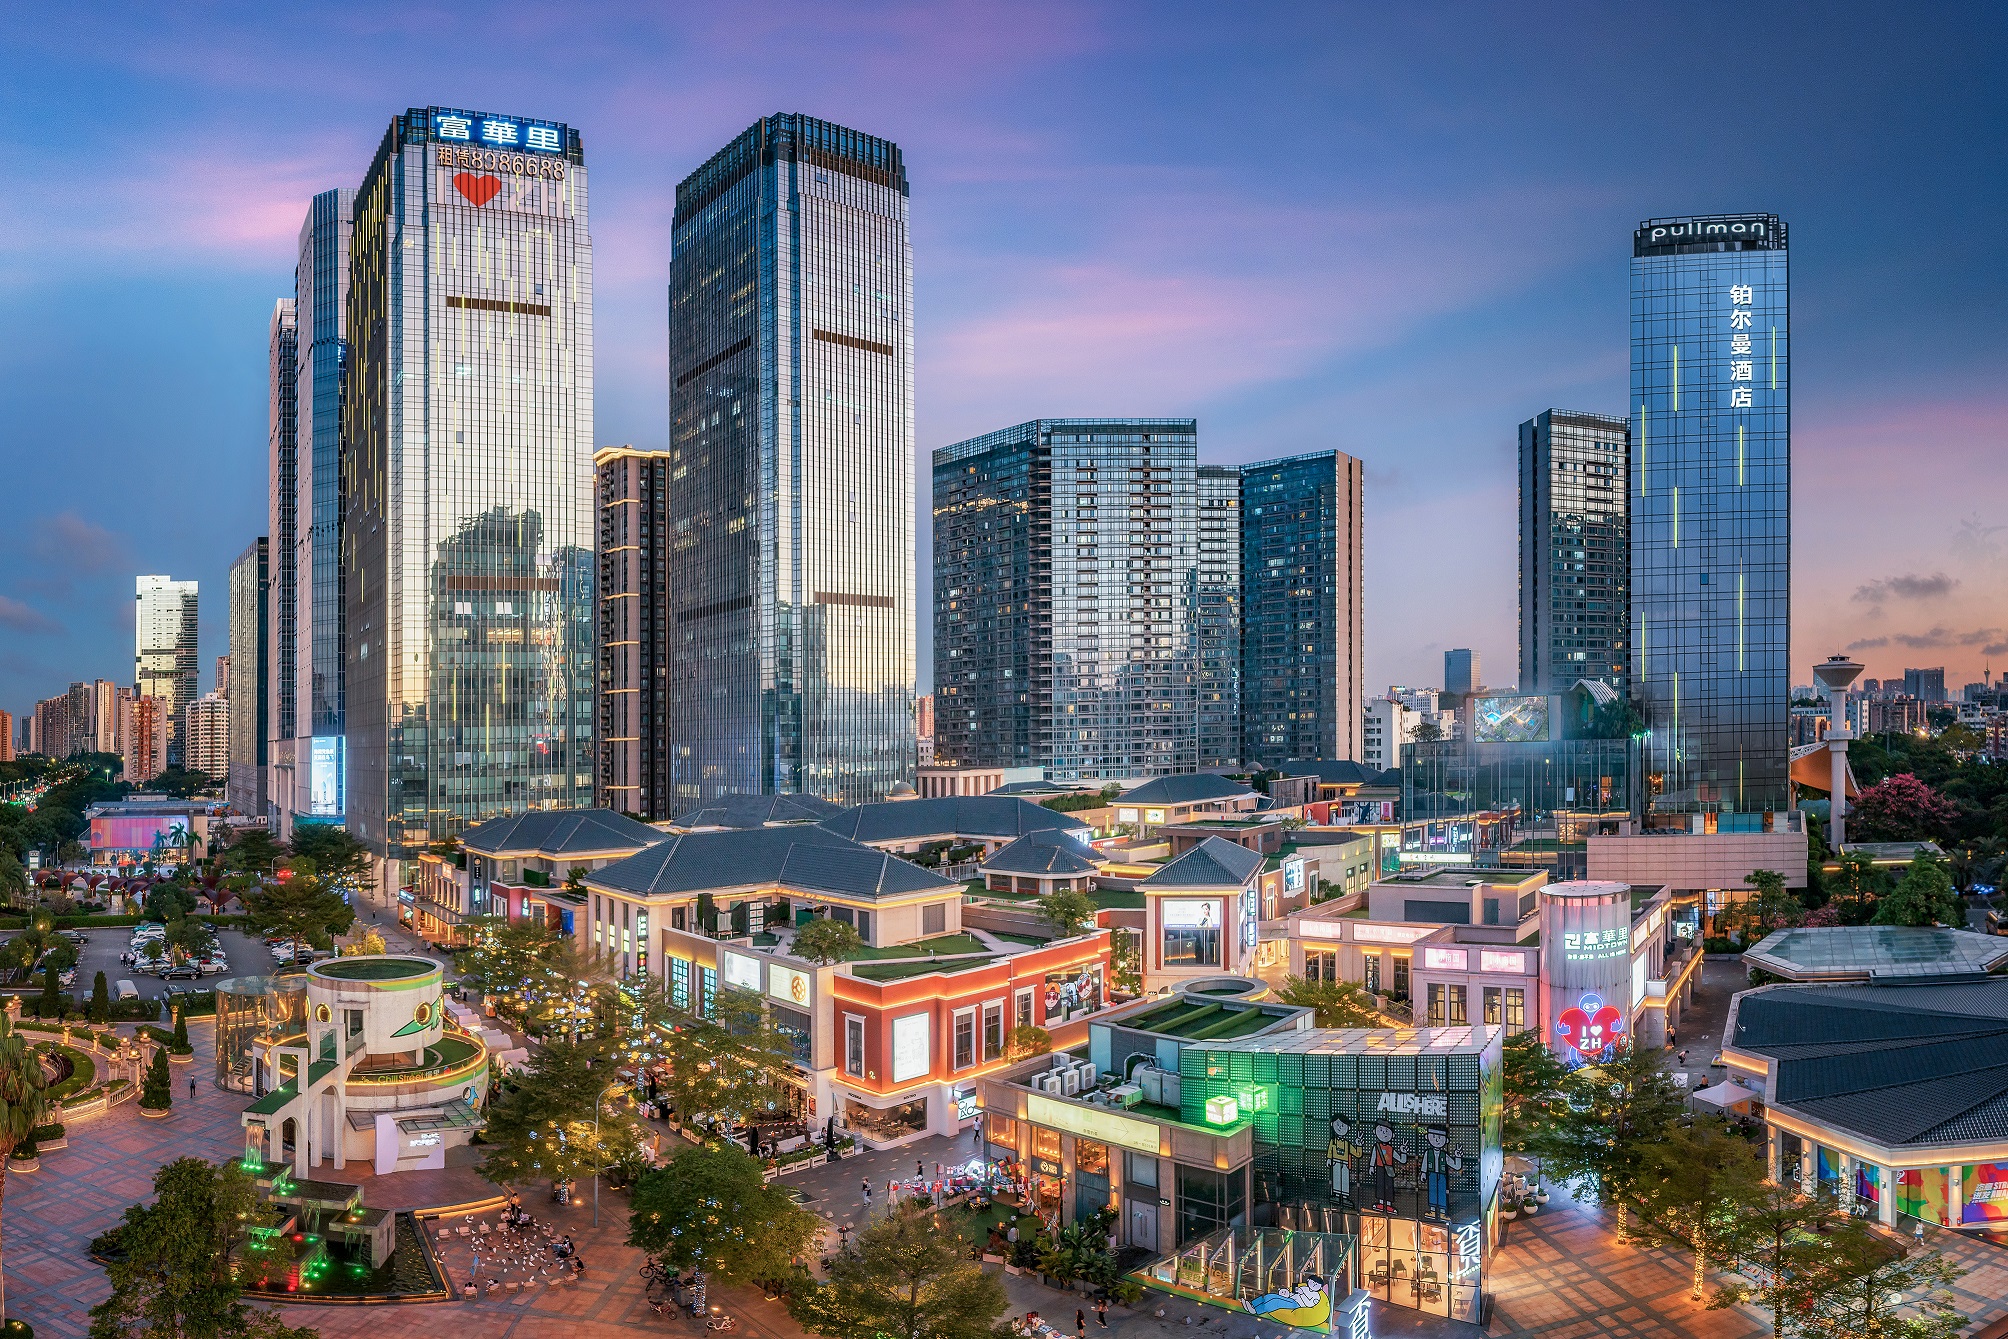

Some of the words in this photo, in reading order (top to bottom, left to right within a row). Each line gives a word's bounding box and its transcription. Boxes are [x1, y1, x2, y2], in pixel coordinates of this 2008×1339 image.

[437, 116, 561, 151] 富華里
[1652, 222, 1764, 241] pullman
[1730, 284, 1753, 408] 铂尔曼酒店
[1584, 926, 1629, 945] 富華里
[1584, 939, 1628, 951] MIDTOWN
[1582, 1025, 1587, 1037] I
[1580, 1037, 1602, 1050] ZH
[378, 1076, 398, 1084] Chill
[399, 1072, 424, 1083] Street
